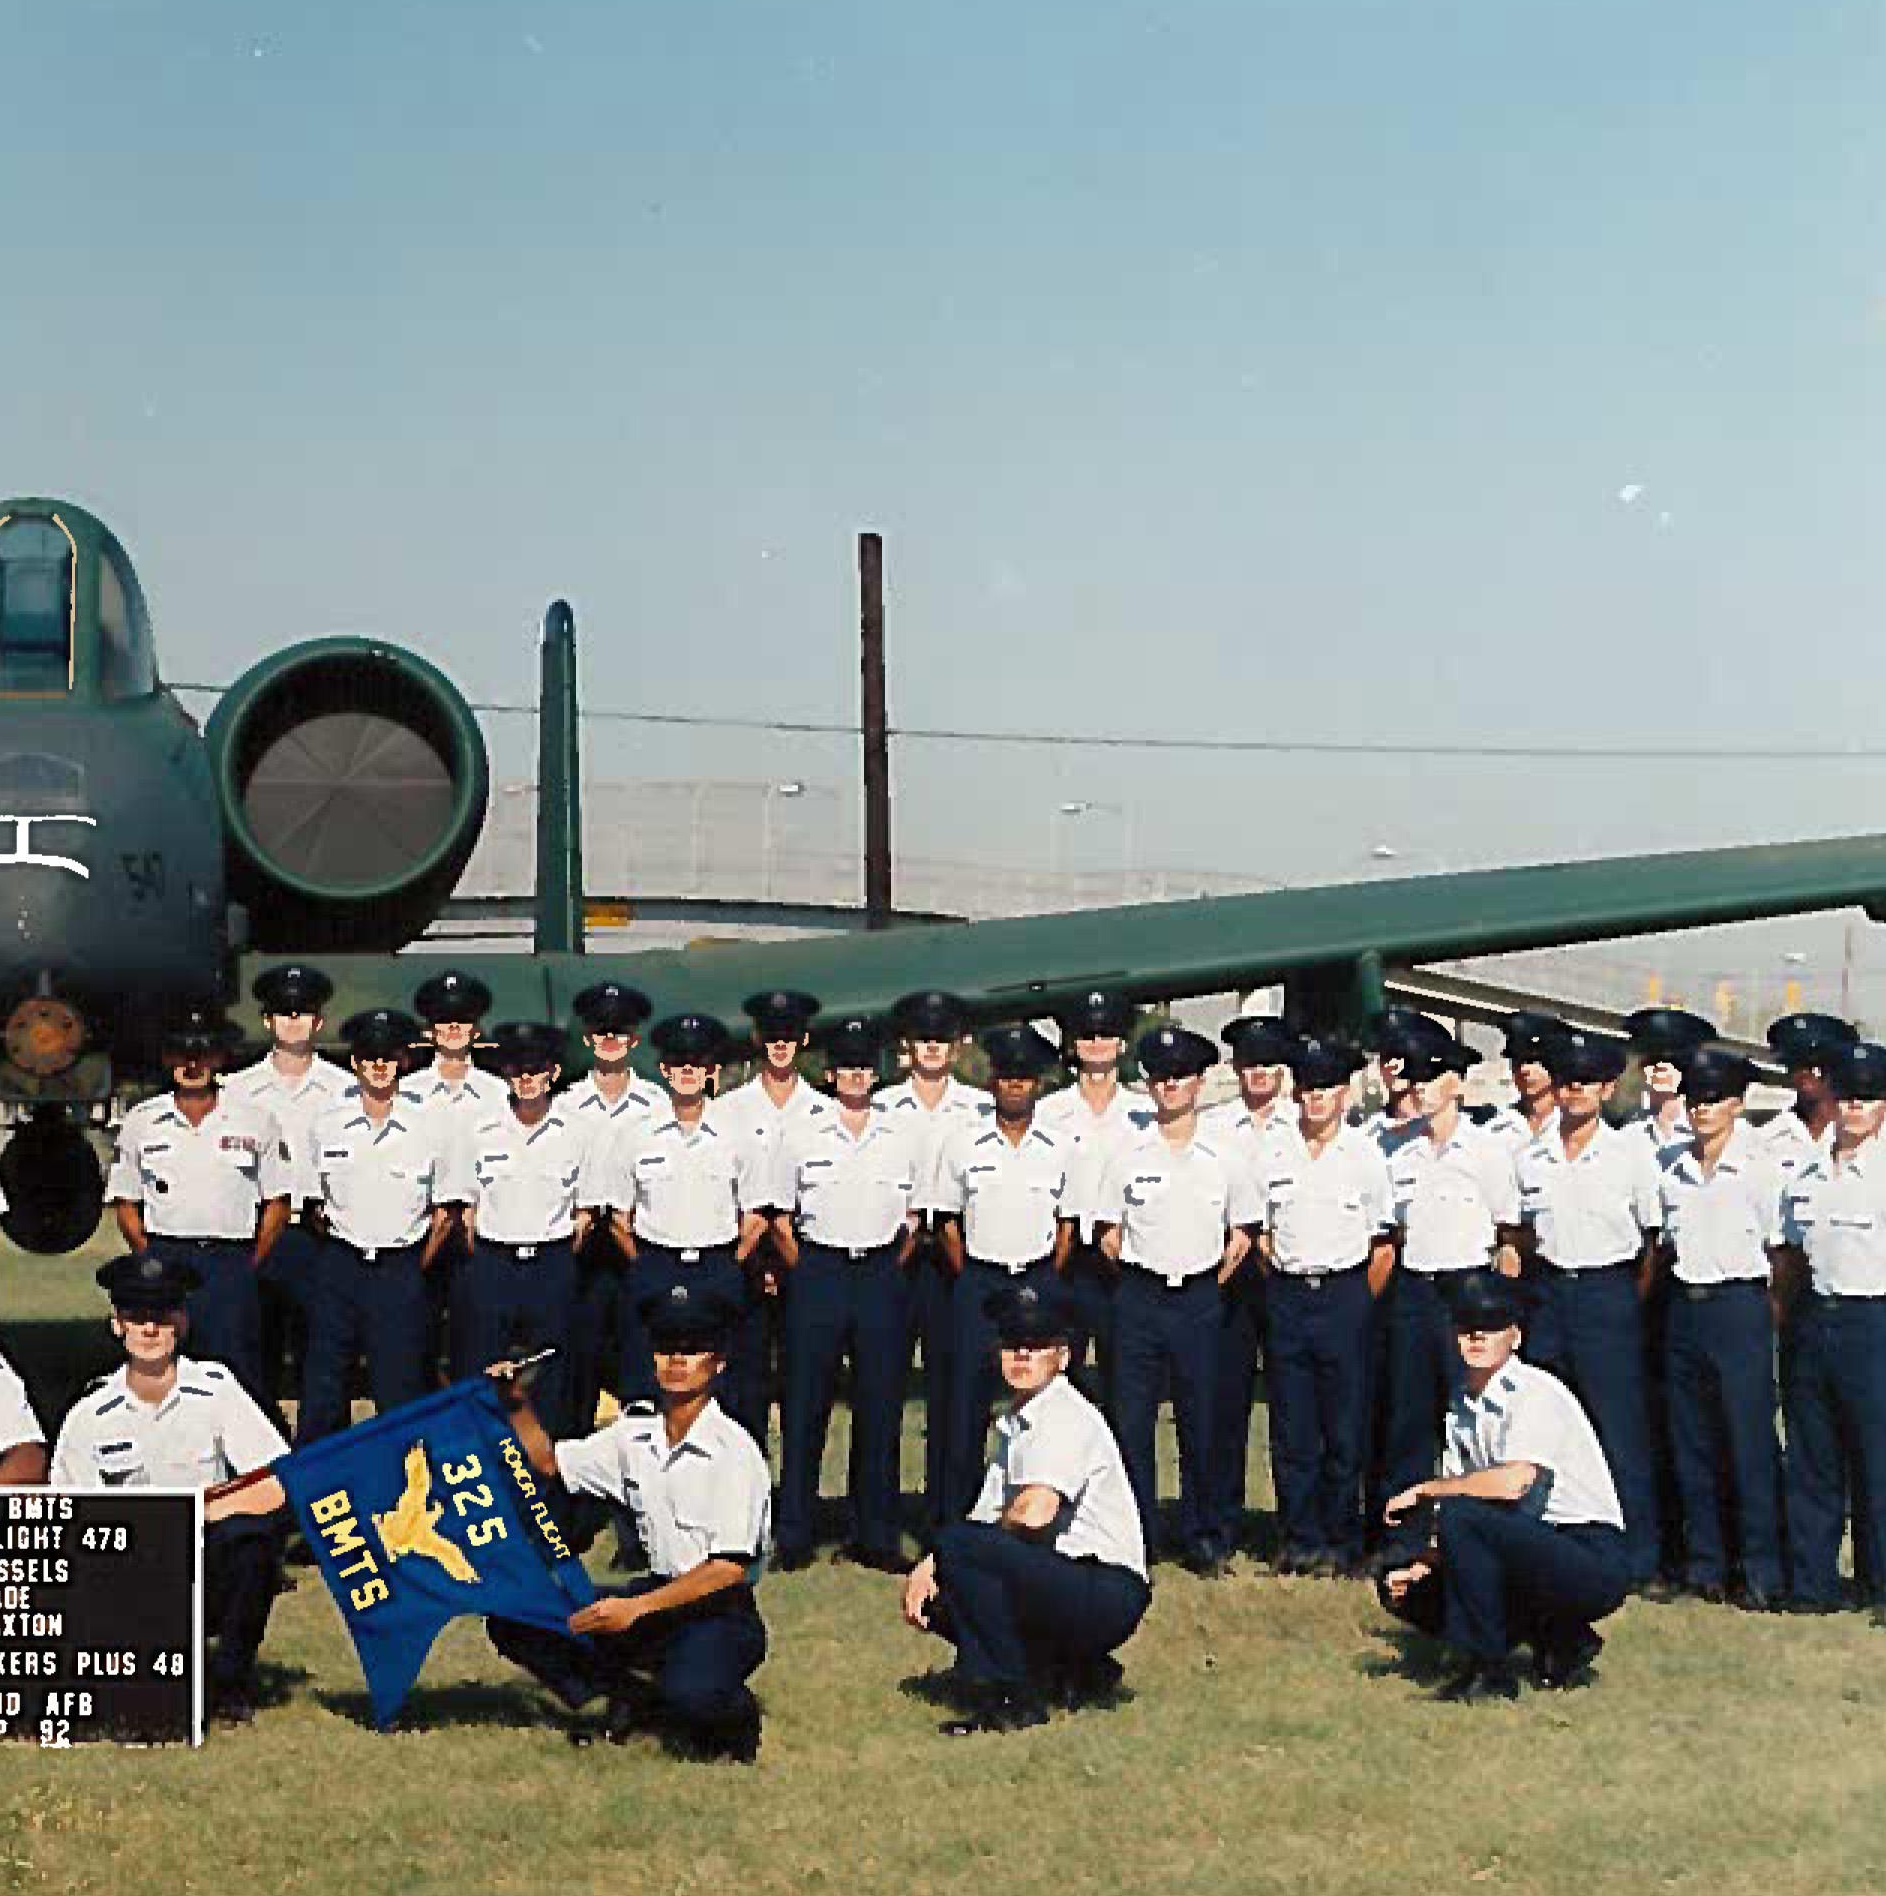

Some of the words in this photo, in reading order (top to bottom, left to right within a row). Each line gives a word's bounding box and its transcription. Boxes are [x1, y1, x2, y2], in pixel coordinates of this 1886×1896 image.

[8, 1497, 73, 1520] BMTS
[442, 1454, 508, 1547] 325
[82, 1527, 127, 1551] 478
[310, 1489, 390, 1611] BMTS
[77, 1651, 136, 1676] PLUS
[152, 1652, 184, 1676] 48
[46, 1692, 93, 1716] AFB
[39, 1719, 72, 1747] 92
